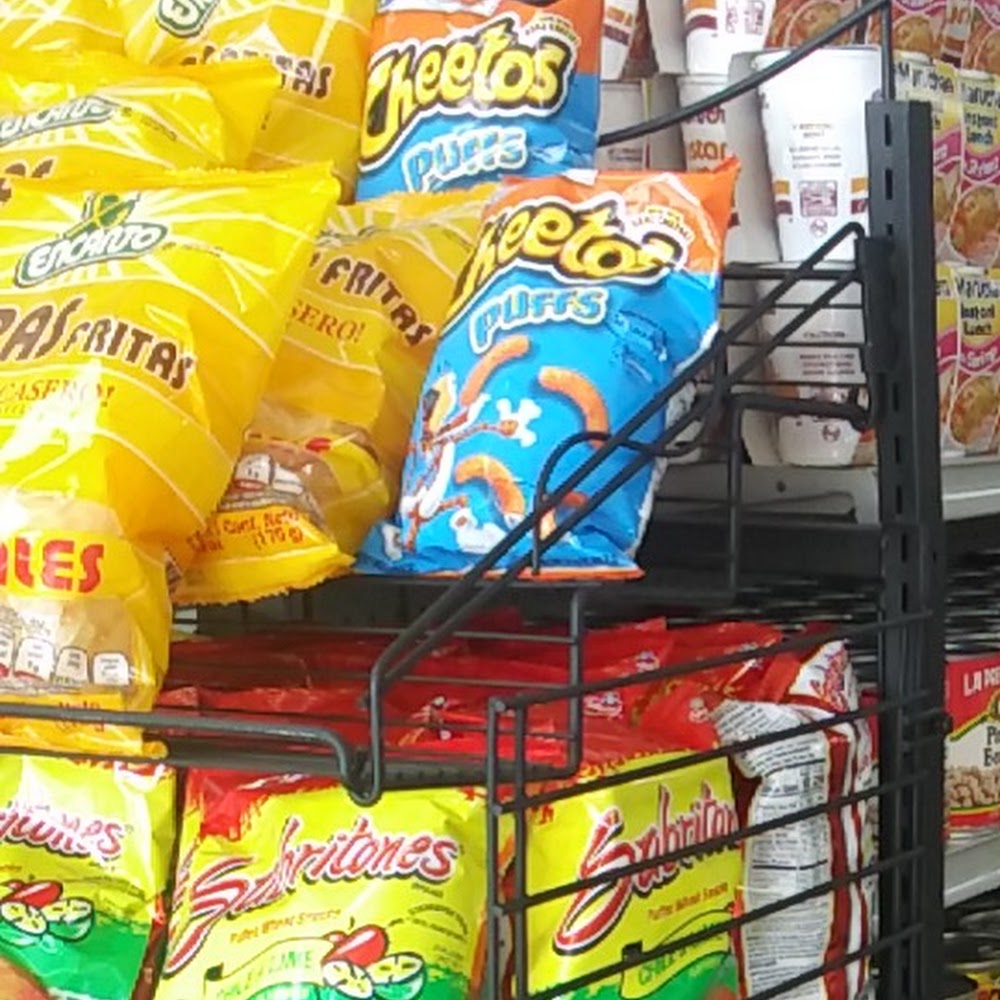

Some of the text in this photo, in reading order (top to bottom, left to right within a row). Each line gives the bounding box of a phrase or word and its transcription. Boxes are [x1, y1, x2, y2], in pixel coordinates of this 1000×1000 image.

[361, 20, 566, 160] Cheetos
[28, 225, 164, 277] ENCANTO
[321, 255, 434, 347] FRITAS
[62, 318, 194, 390] FRITAS
[963, 670, 983, 697] LA
[163, 816, 460, 976] Sabritones
